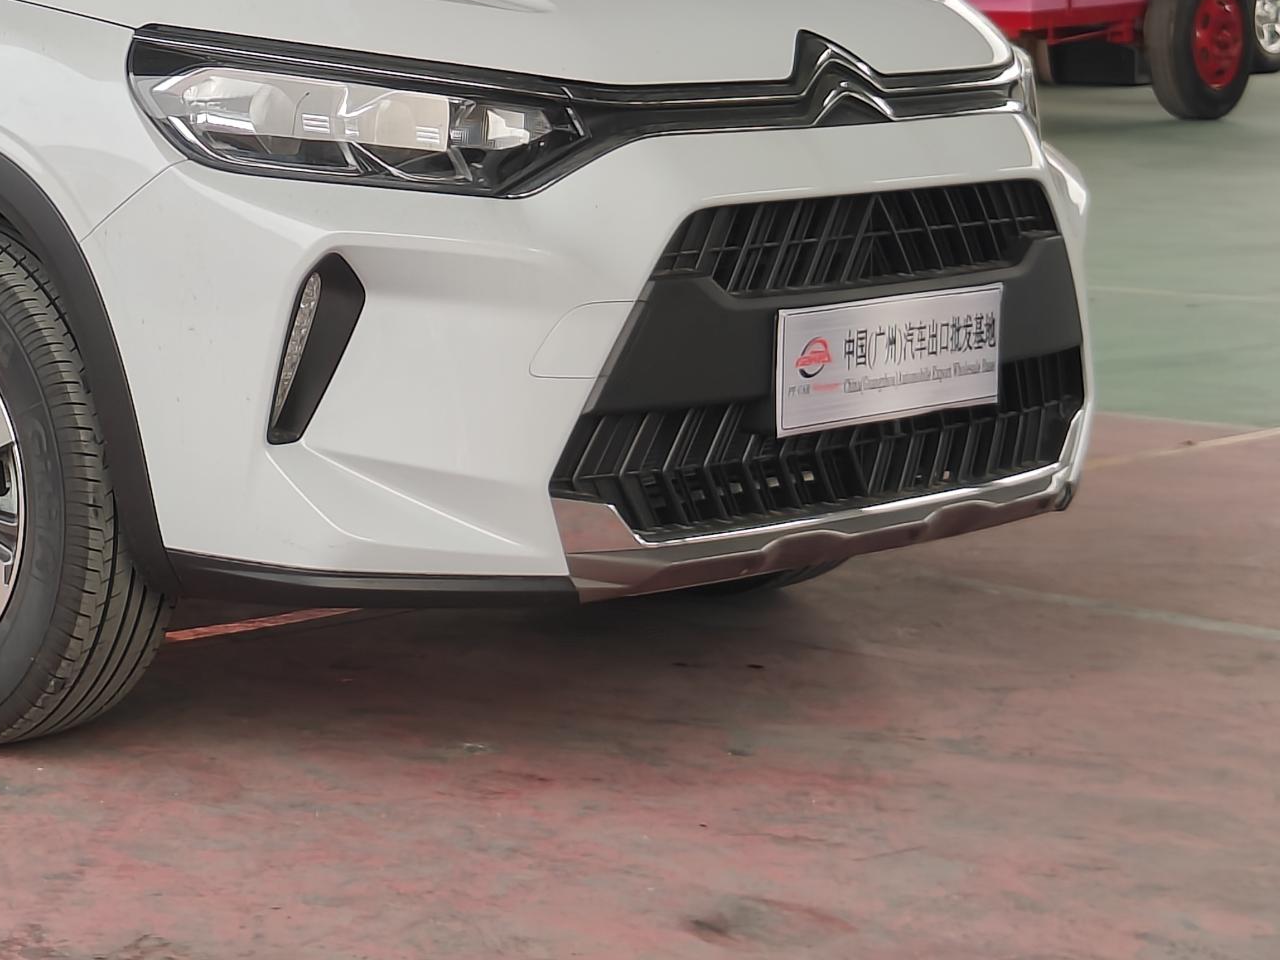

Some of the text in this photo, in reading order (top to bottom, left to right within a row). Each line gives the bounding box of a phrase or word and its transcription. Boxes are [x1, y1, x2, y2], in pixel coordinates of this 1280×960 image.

[842, 311, 997, 371] 中国(广州)汽车出口批发基地
